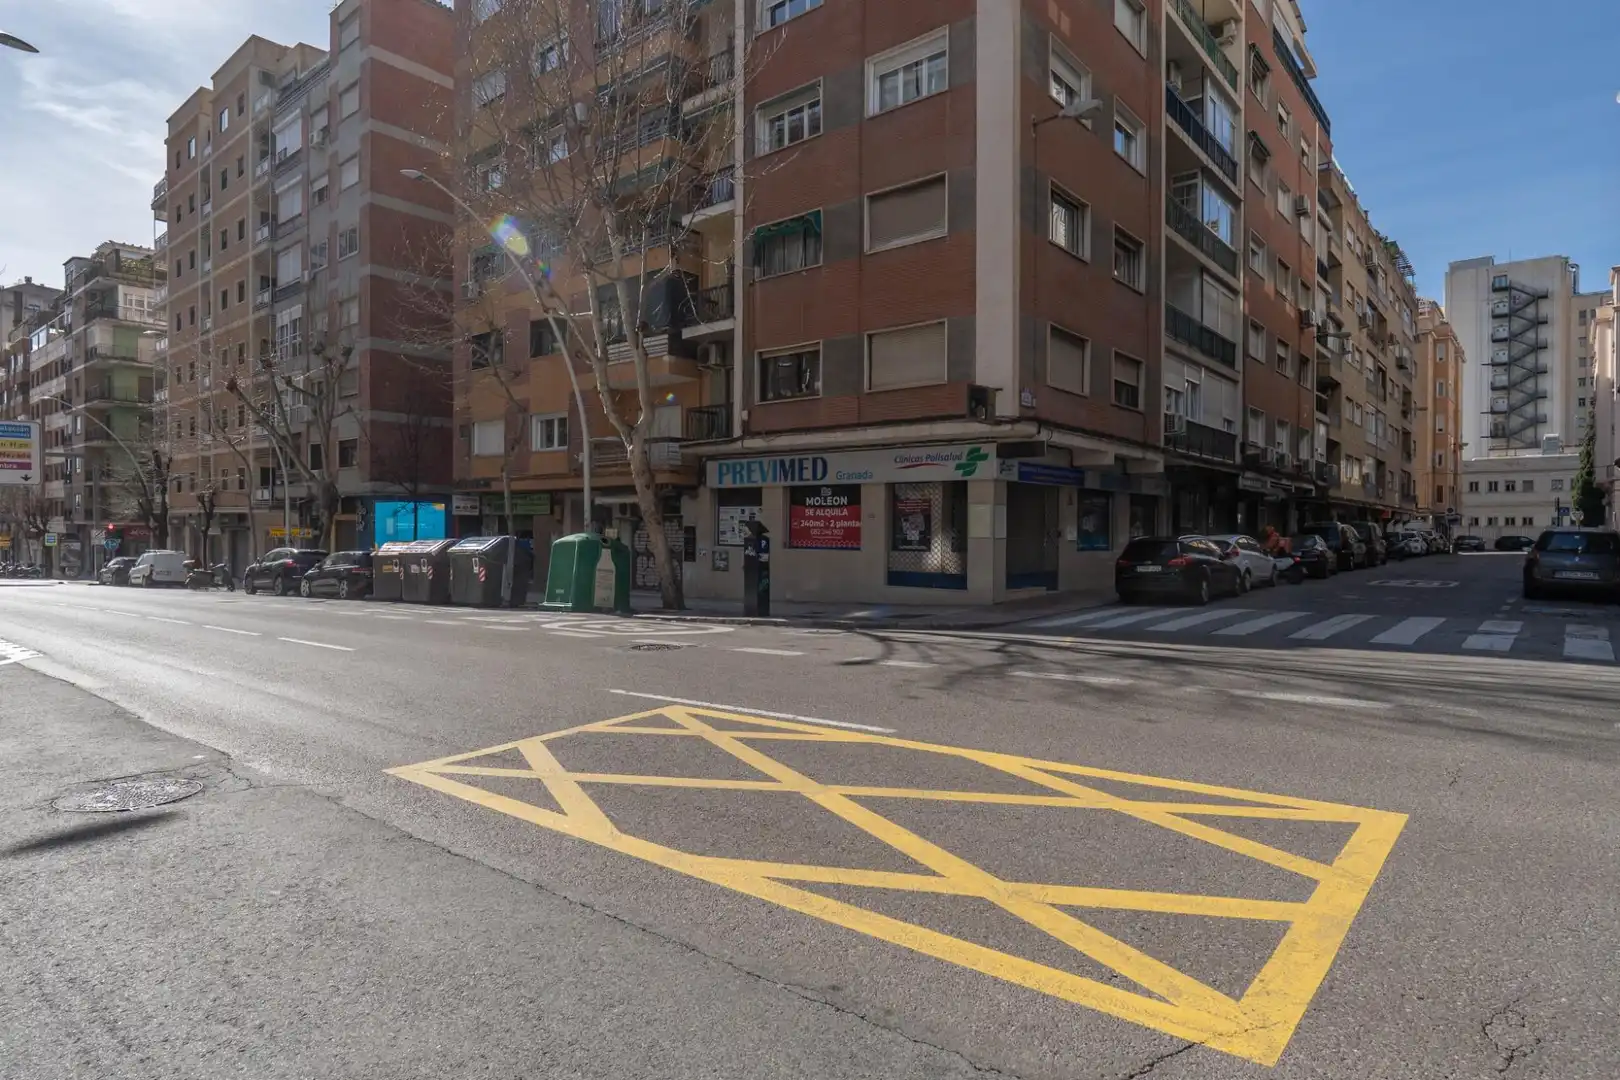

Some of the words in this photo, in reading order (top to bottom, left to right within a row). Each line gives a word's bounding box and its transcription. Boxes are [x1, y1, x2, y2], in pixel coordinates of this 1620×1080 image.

[925, 451, 963, 462] Polisalud
[718, 457, 828, 485] PREVIMED
[836, 470, 873, 481] Granada
[805, 508, 815, 516] SE
[816, 508, 848, 517] ALQUILA
